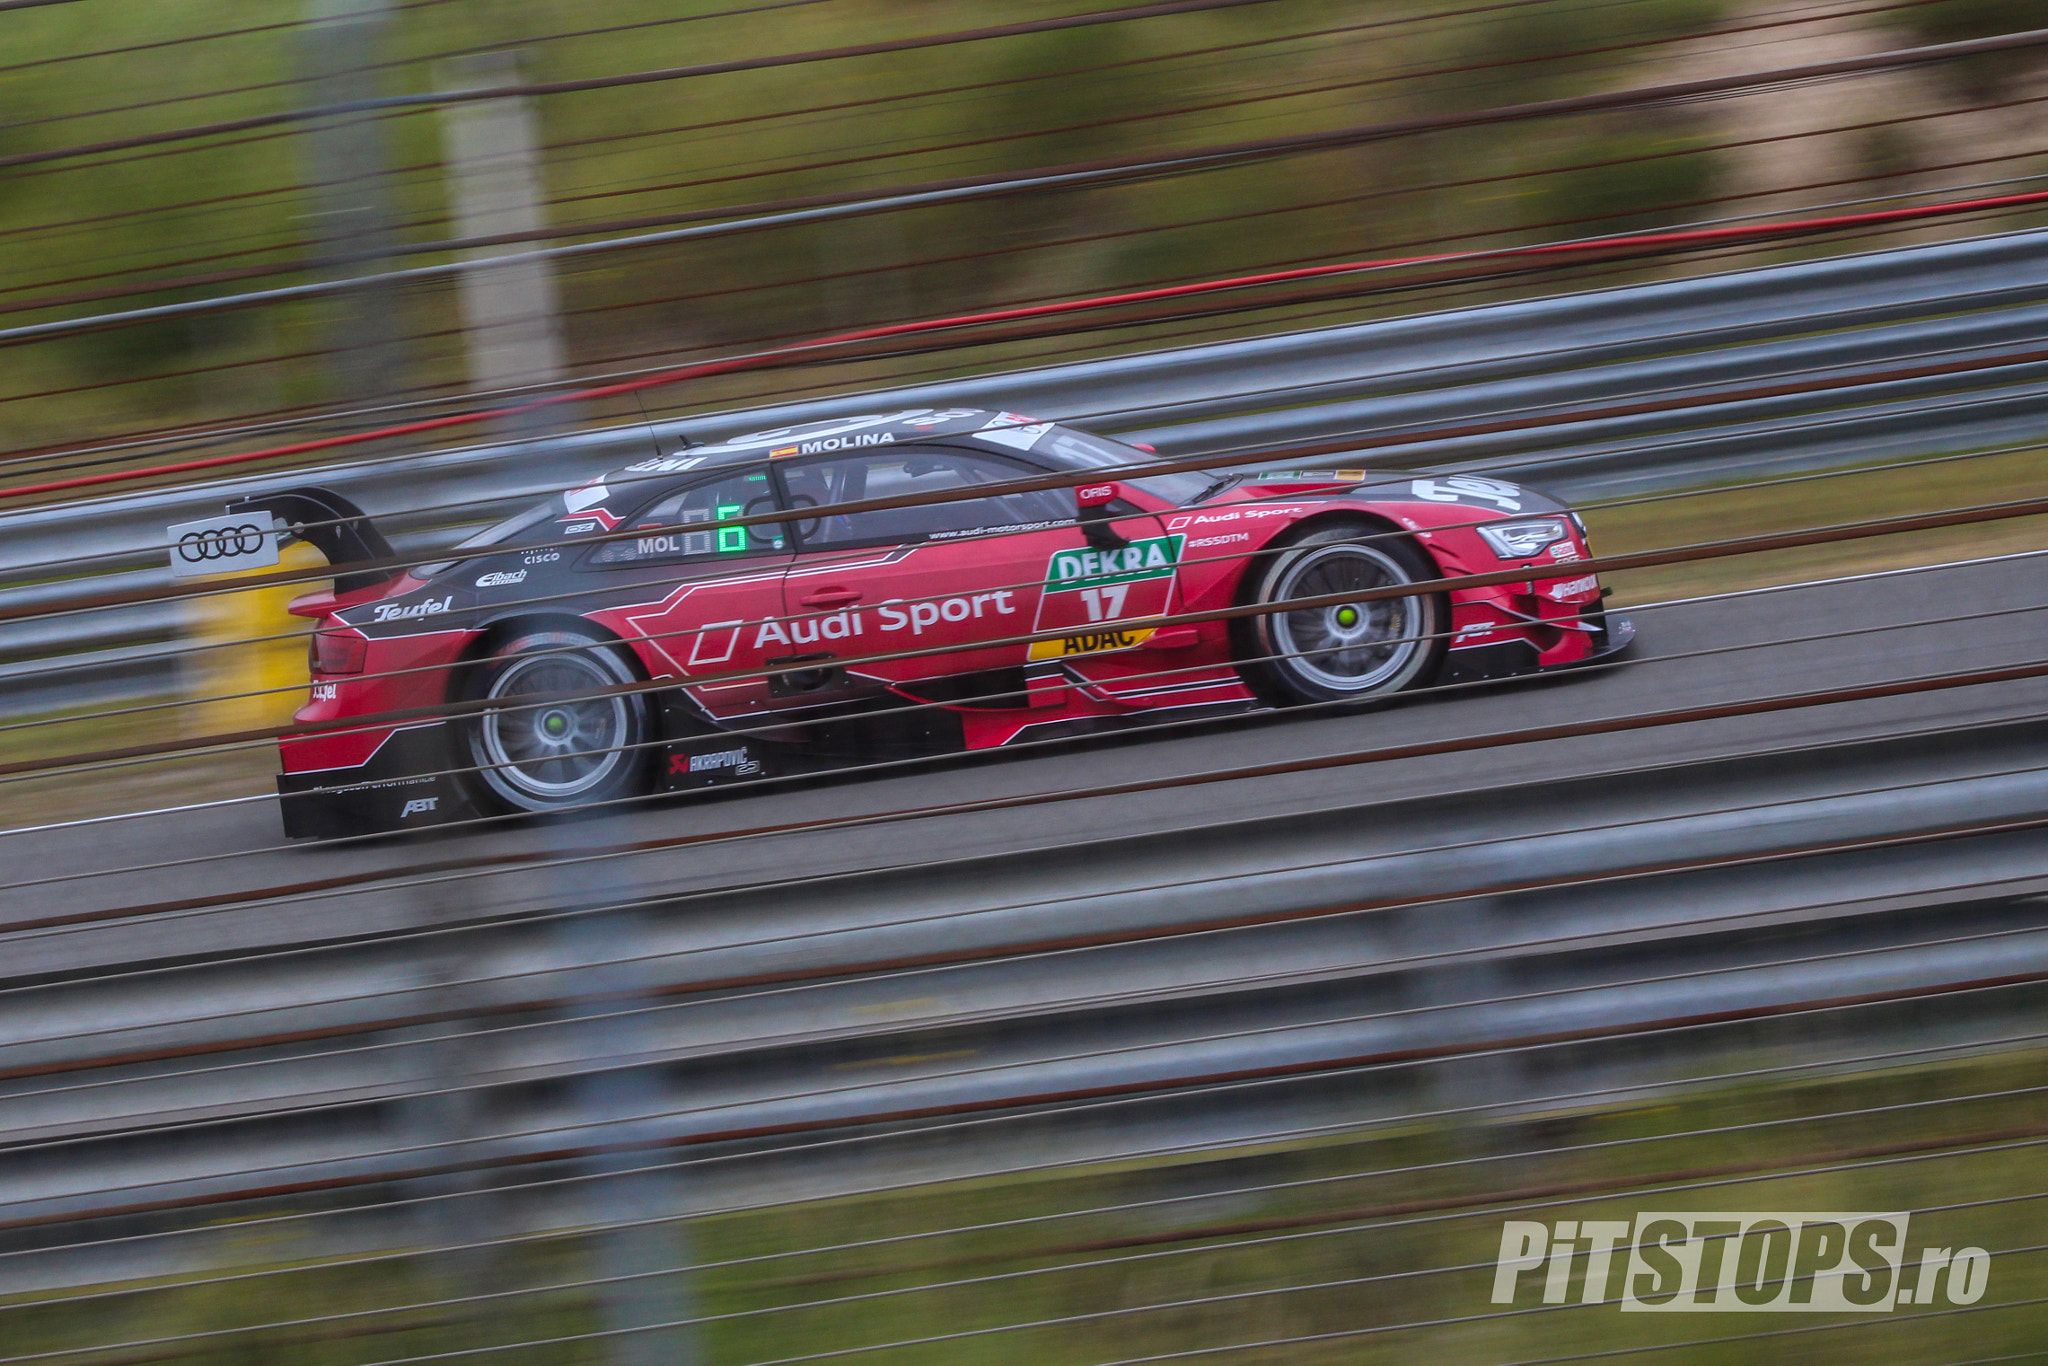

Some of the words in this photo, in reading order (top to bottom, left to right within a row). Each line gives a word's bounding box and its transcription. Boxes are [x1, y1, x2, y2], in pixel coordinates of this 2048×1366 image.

[801, 432, 895, 454] MOLINA
[1079, 484, 1113, 499] ORIS
[1194, 510, 1240, 524] Audi
[1244, 507, 1303, 522] Sport
[717, 505, 746, 552] 6
[929, 517, 1076, 540] www.audi-motorsport.com
[637, 536, 680, 554] MOL
[1058, 543, 1171, 585] DEKRA
[475, 568, 528, 587] Eibach
[374, 595, 453, 622] Teufel
[1080, 584, 1130, 622] 17
[753, 604, 863, 649] Audi
[878, 590, 1016, 636] Sport
[1064, 631, 1136, 655] ADAC
[400, 797, 439, 818] ABT
